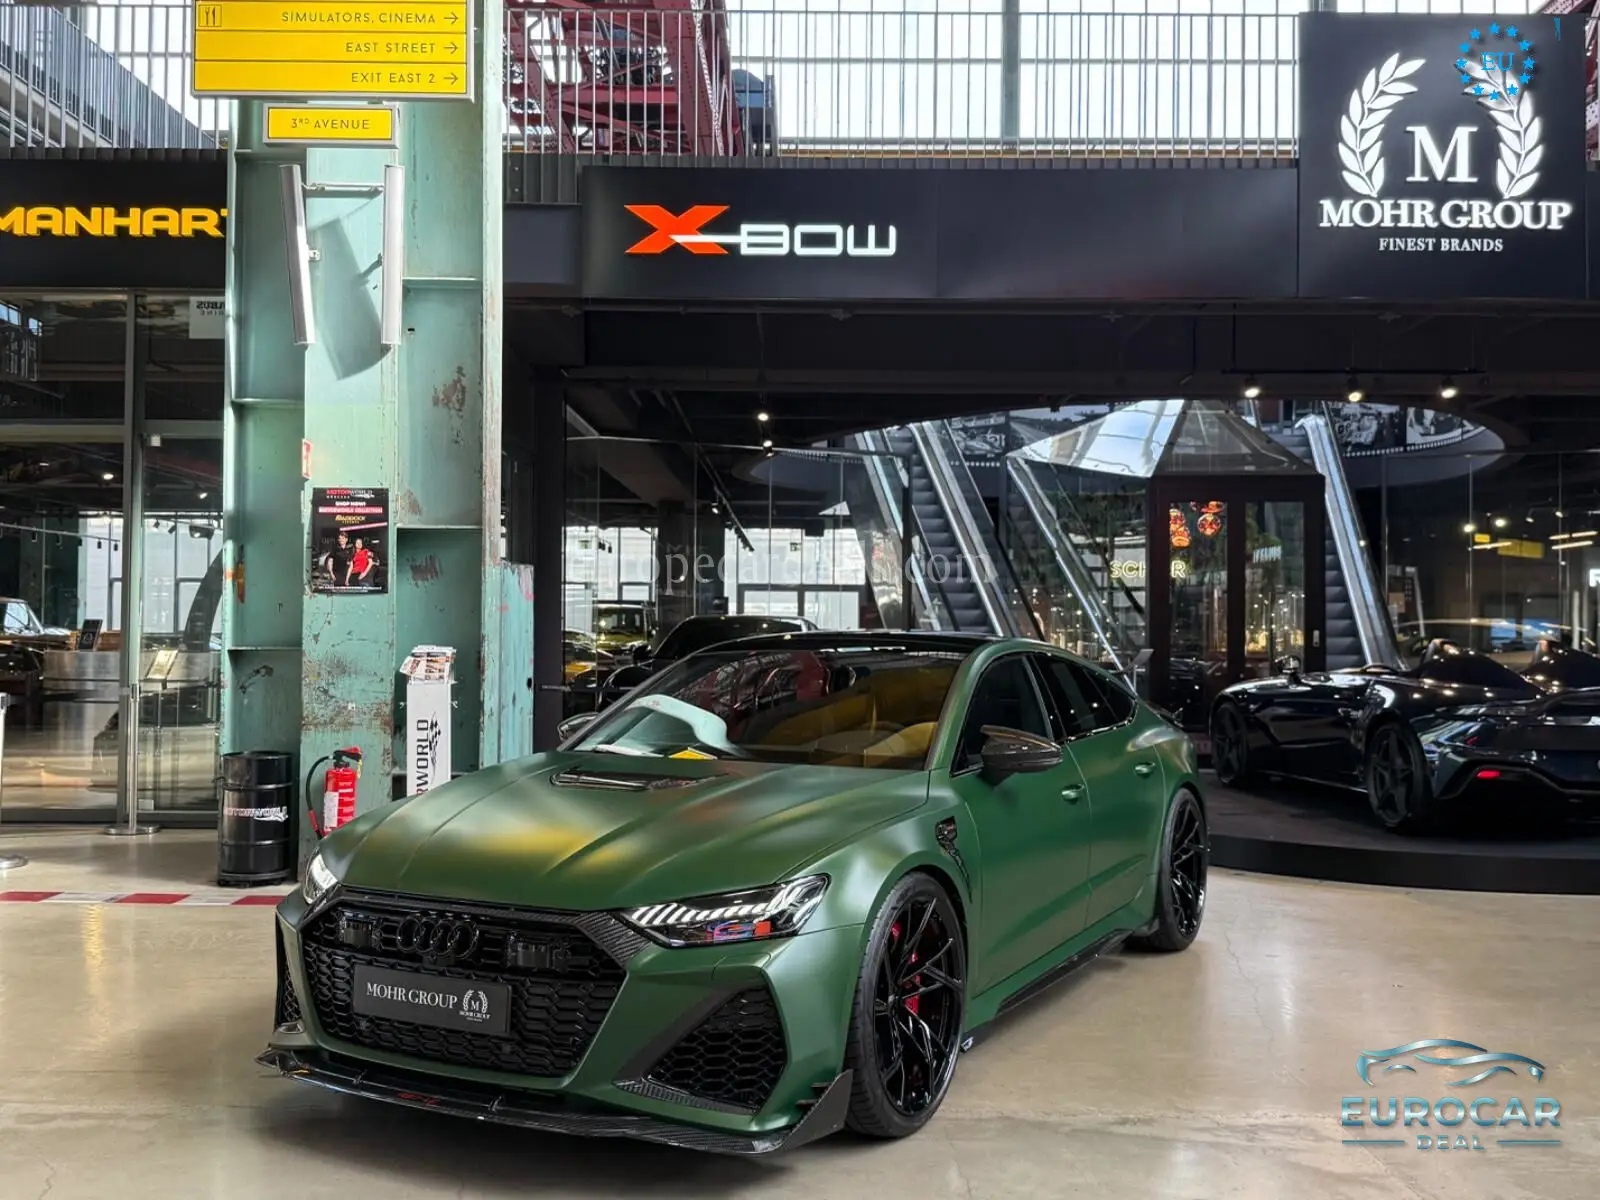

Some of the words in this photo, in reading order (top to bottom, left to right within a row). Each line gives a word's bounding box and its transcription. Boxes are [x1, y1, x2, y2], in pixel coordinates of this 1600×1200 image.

[281, 12, 375, 24] SIMULATORS,
[379, 13, 436, 24] CINEMA
[345, 42, 379, 53] EAST
[386, 43, 436, 54] STREET
[351, 72, 382, 83] EXIT
[389, 73, 422, 84] EAST
[428, 73, 436, 84] 2
[314, 119, 370, 130] AVENUE
[1406, 126, 1478, 182] M
[1319, 200, 1438, 228] MOHR
[1440, 200, 1572, 229] GROUP
[0, 207, 228, 237] MANHAR
[1379, 238, 1436, 251] FINEST
[1440, 238, 1503, 252] BRANDS
[366, 982, 407, 1002] MOHR
[408, 989, 458, 1009] GROUP
